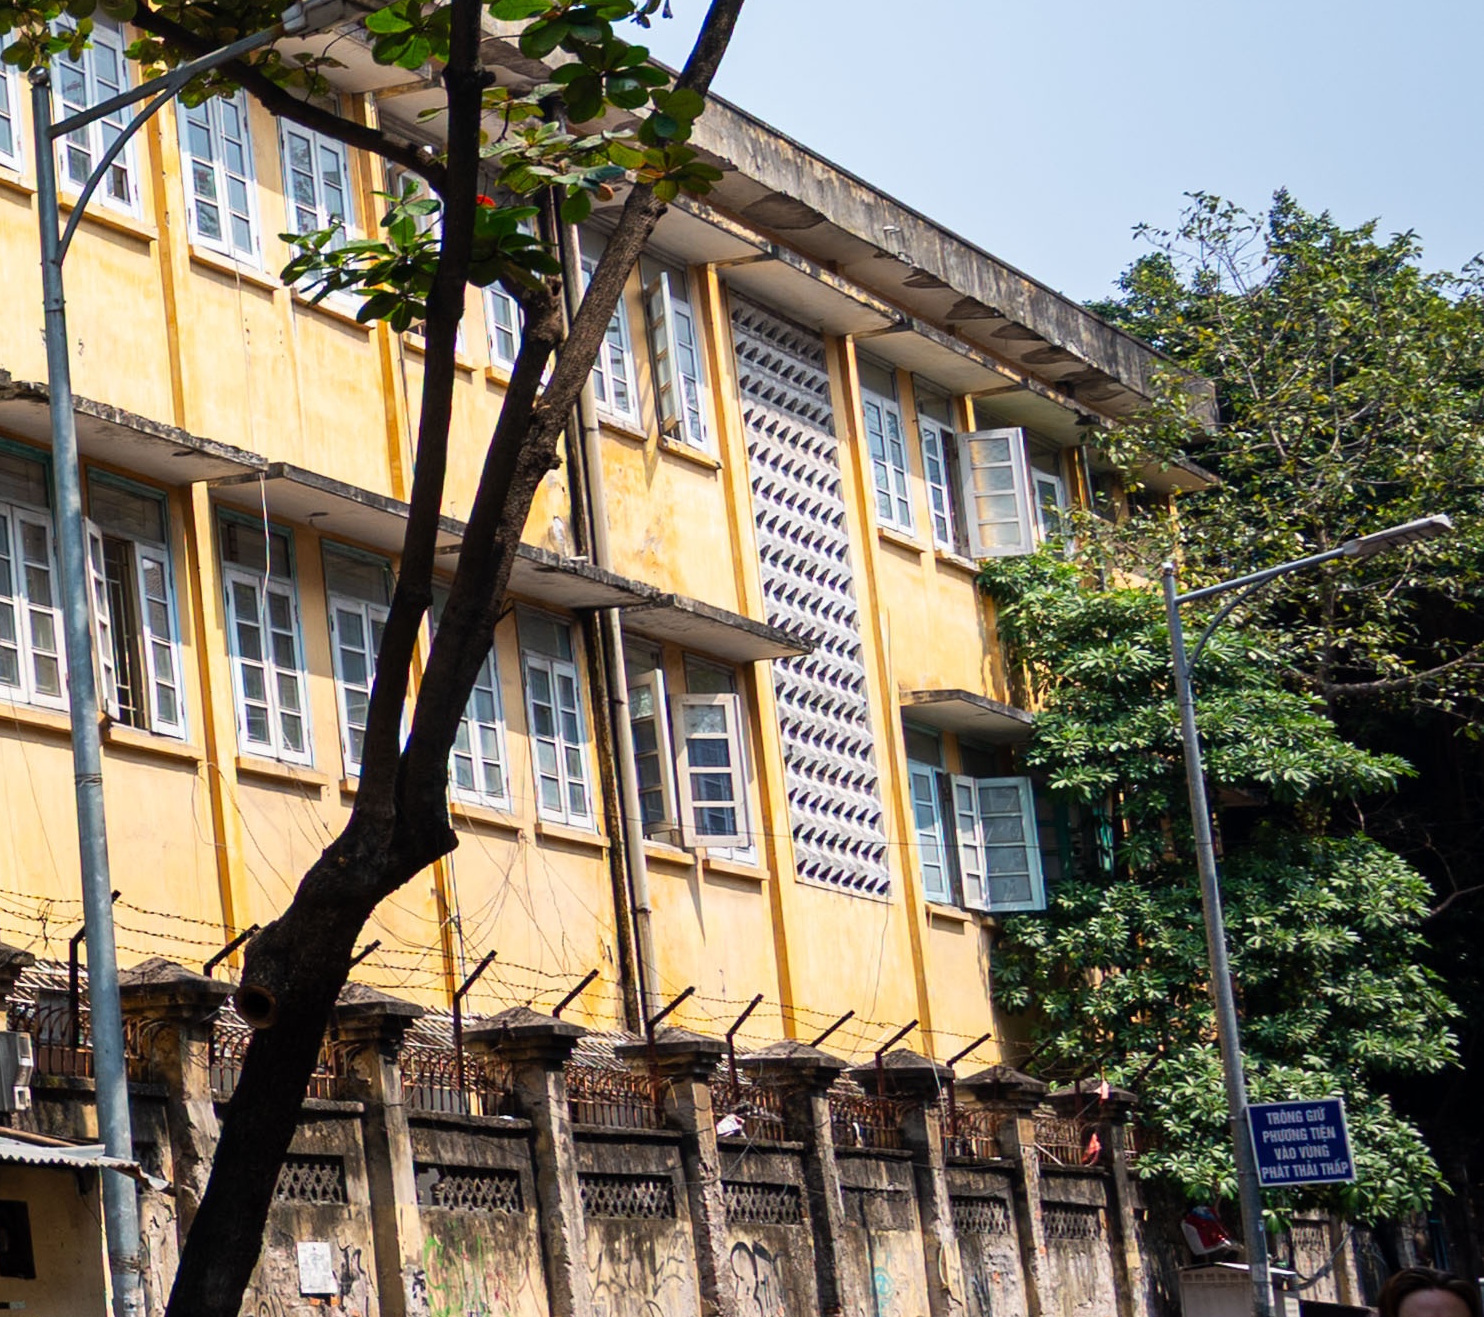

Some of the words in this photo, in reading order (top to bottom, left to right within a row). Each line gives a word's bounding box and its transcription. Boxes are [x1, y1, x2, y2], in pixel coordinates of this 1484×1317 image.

[1262, 1127, 1308, 1143] PHƯƠNG
[1309, 1124, 1336, 1142] TIỆN
[1274, 1145, 1297, 1160] VÀO
[1298, 1142, 1330, 1159] VÙNG
[1261, 1163, 1290, 1179] PHÁT
[1292, 1160, 1318, 1177] THẢI
[1320, 1158, 1348, 1175] THẤP
